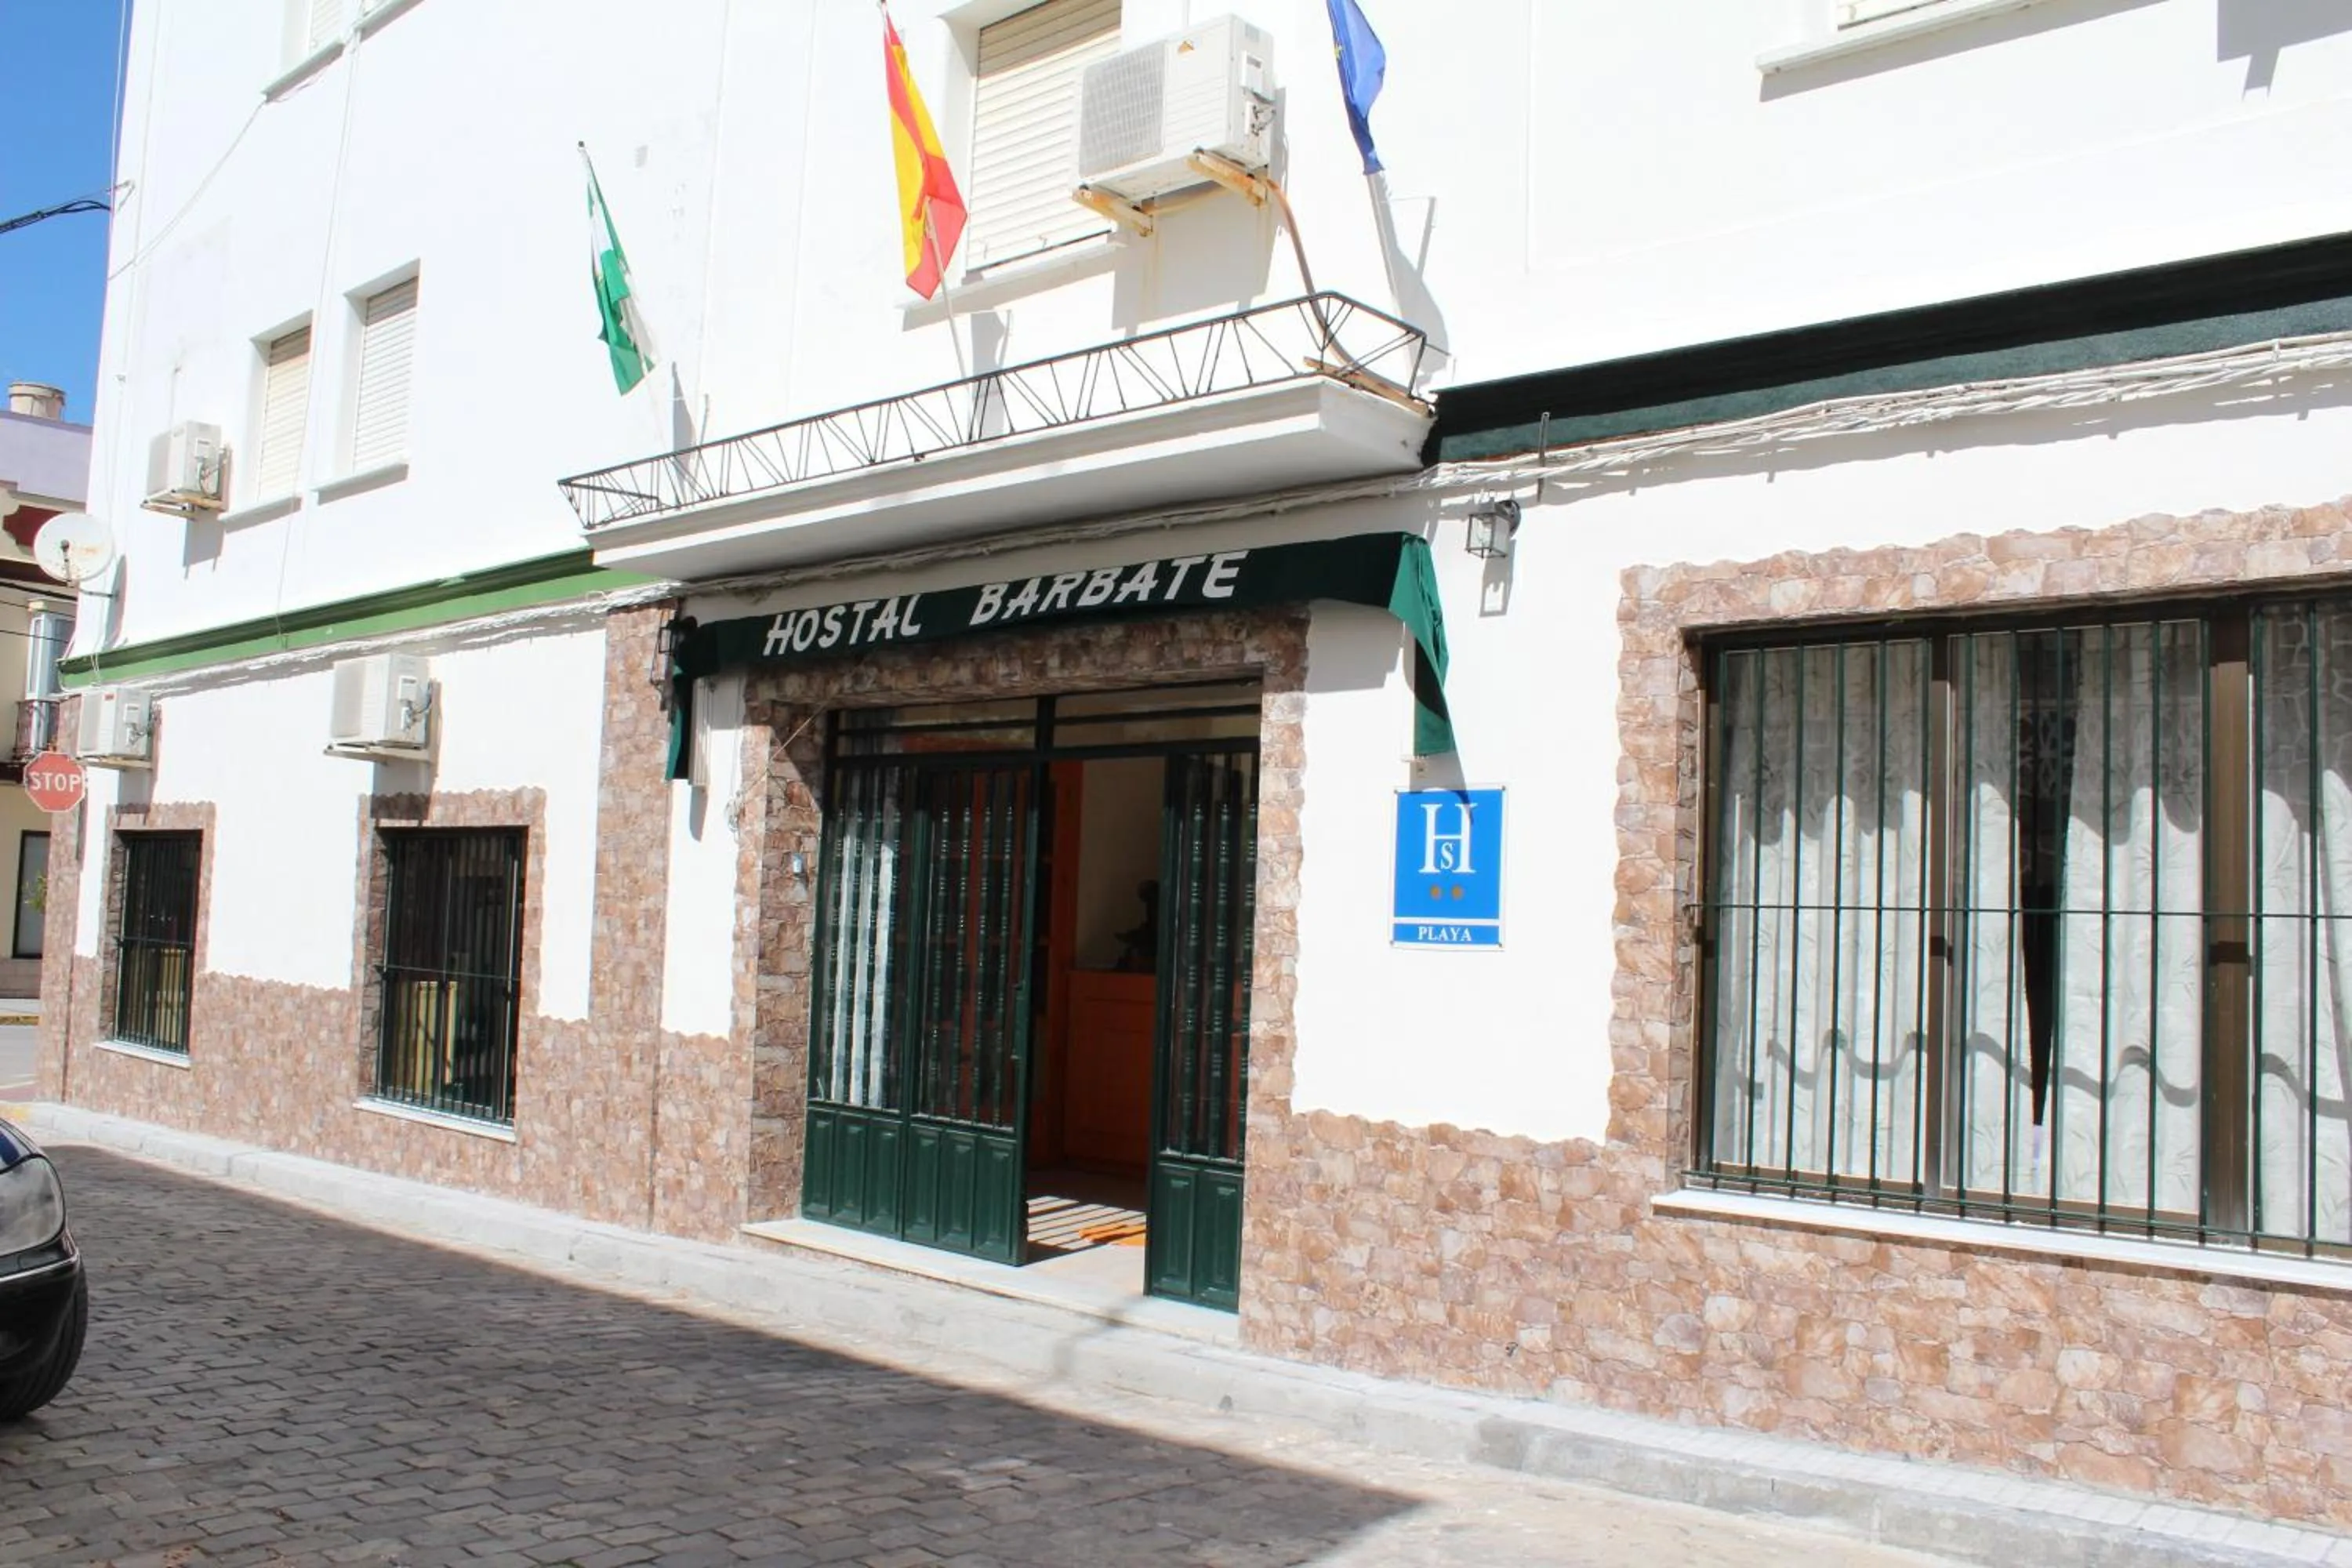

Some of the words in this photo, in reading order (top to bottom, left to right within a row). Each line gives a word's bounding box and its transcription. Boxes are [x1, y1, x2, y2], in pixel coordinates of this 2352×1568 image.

[763, 593, 922, 656] HOSTAL
[969, 550, 1250, 626] BARBATE
[28, 771, 81, 793] STOP
[1417, 925, 1472, 942] PLAYA
